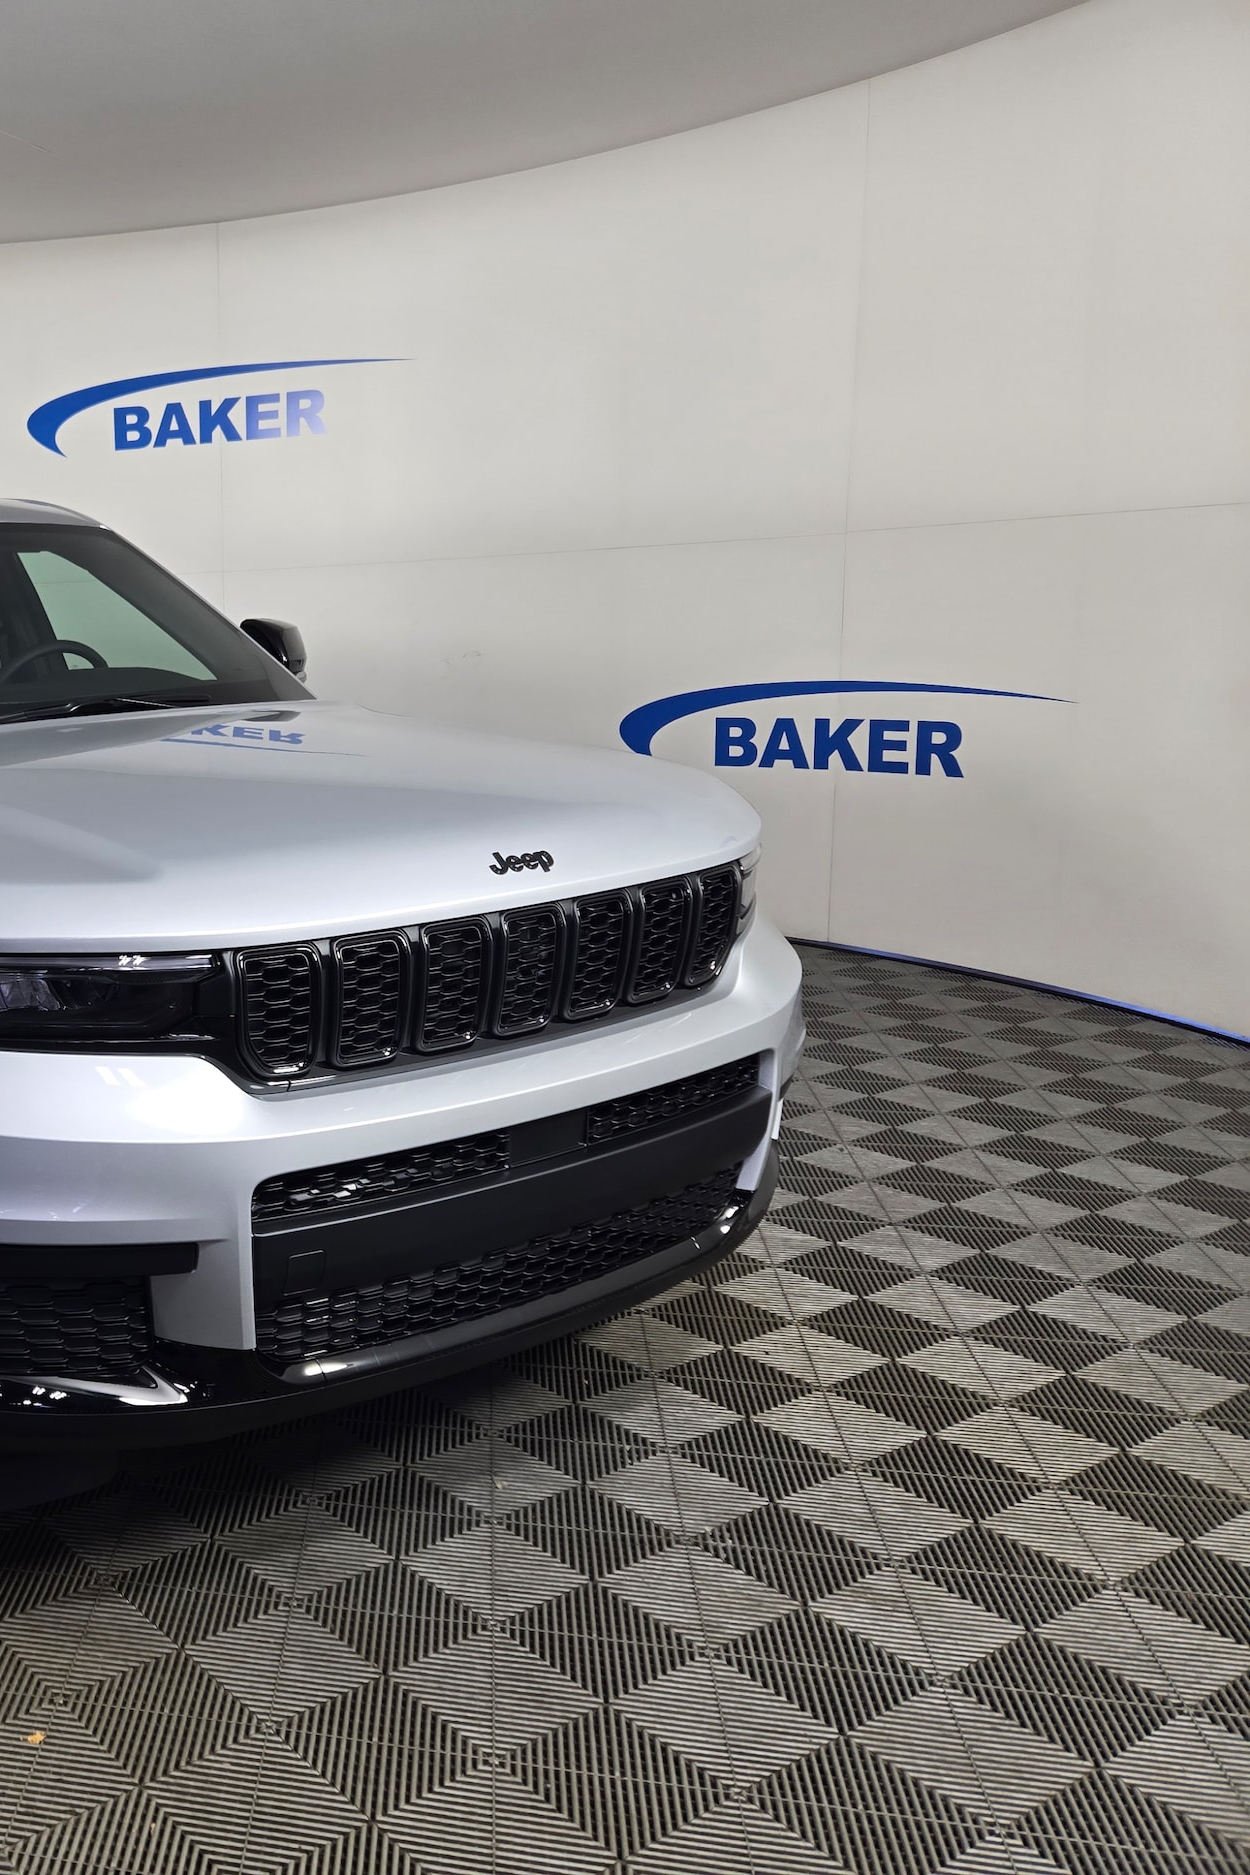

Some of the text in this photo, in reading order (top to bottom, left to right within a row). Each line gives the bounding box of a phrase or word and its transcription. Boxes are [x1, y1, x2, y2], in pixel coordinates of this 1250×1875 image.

[113, 389, 327, 451] BAKER
[714, 717, 964, 778] BAKER
[488, 850, 554, 875] Jeep
